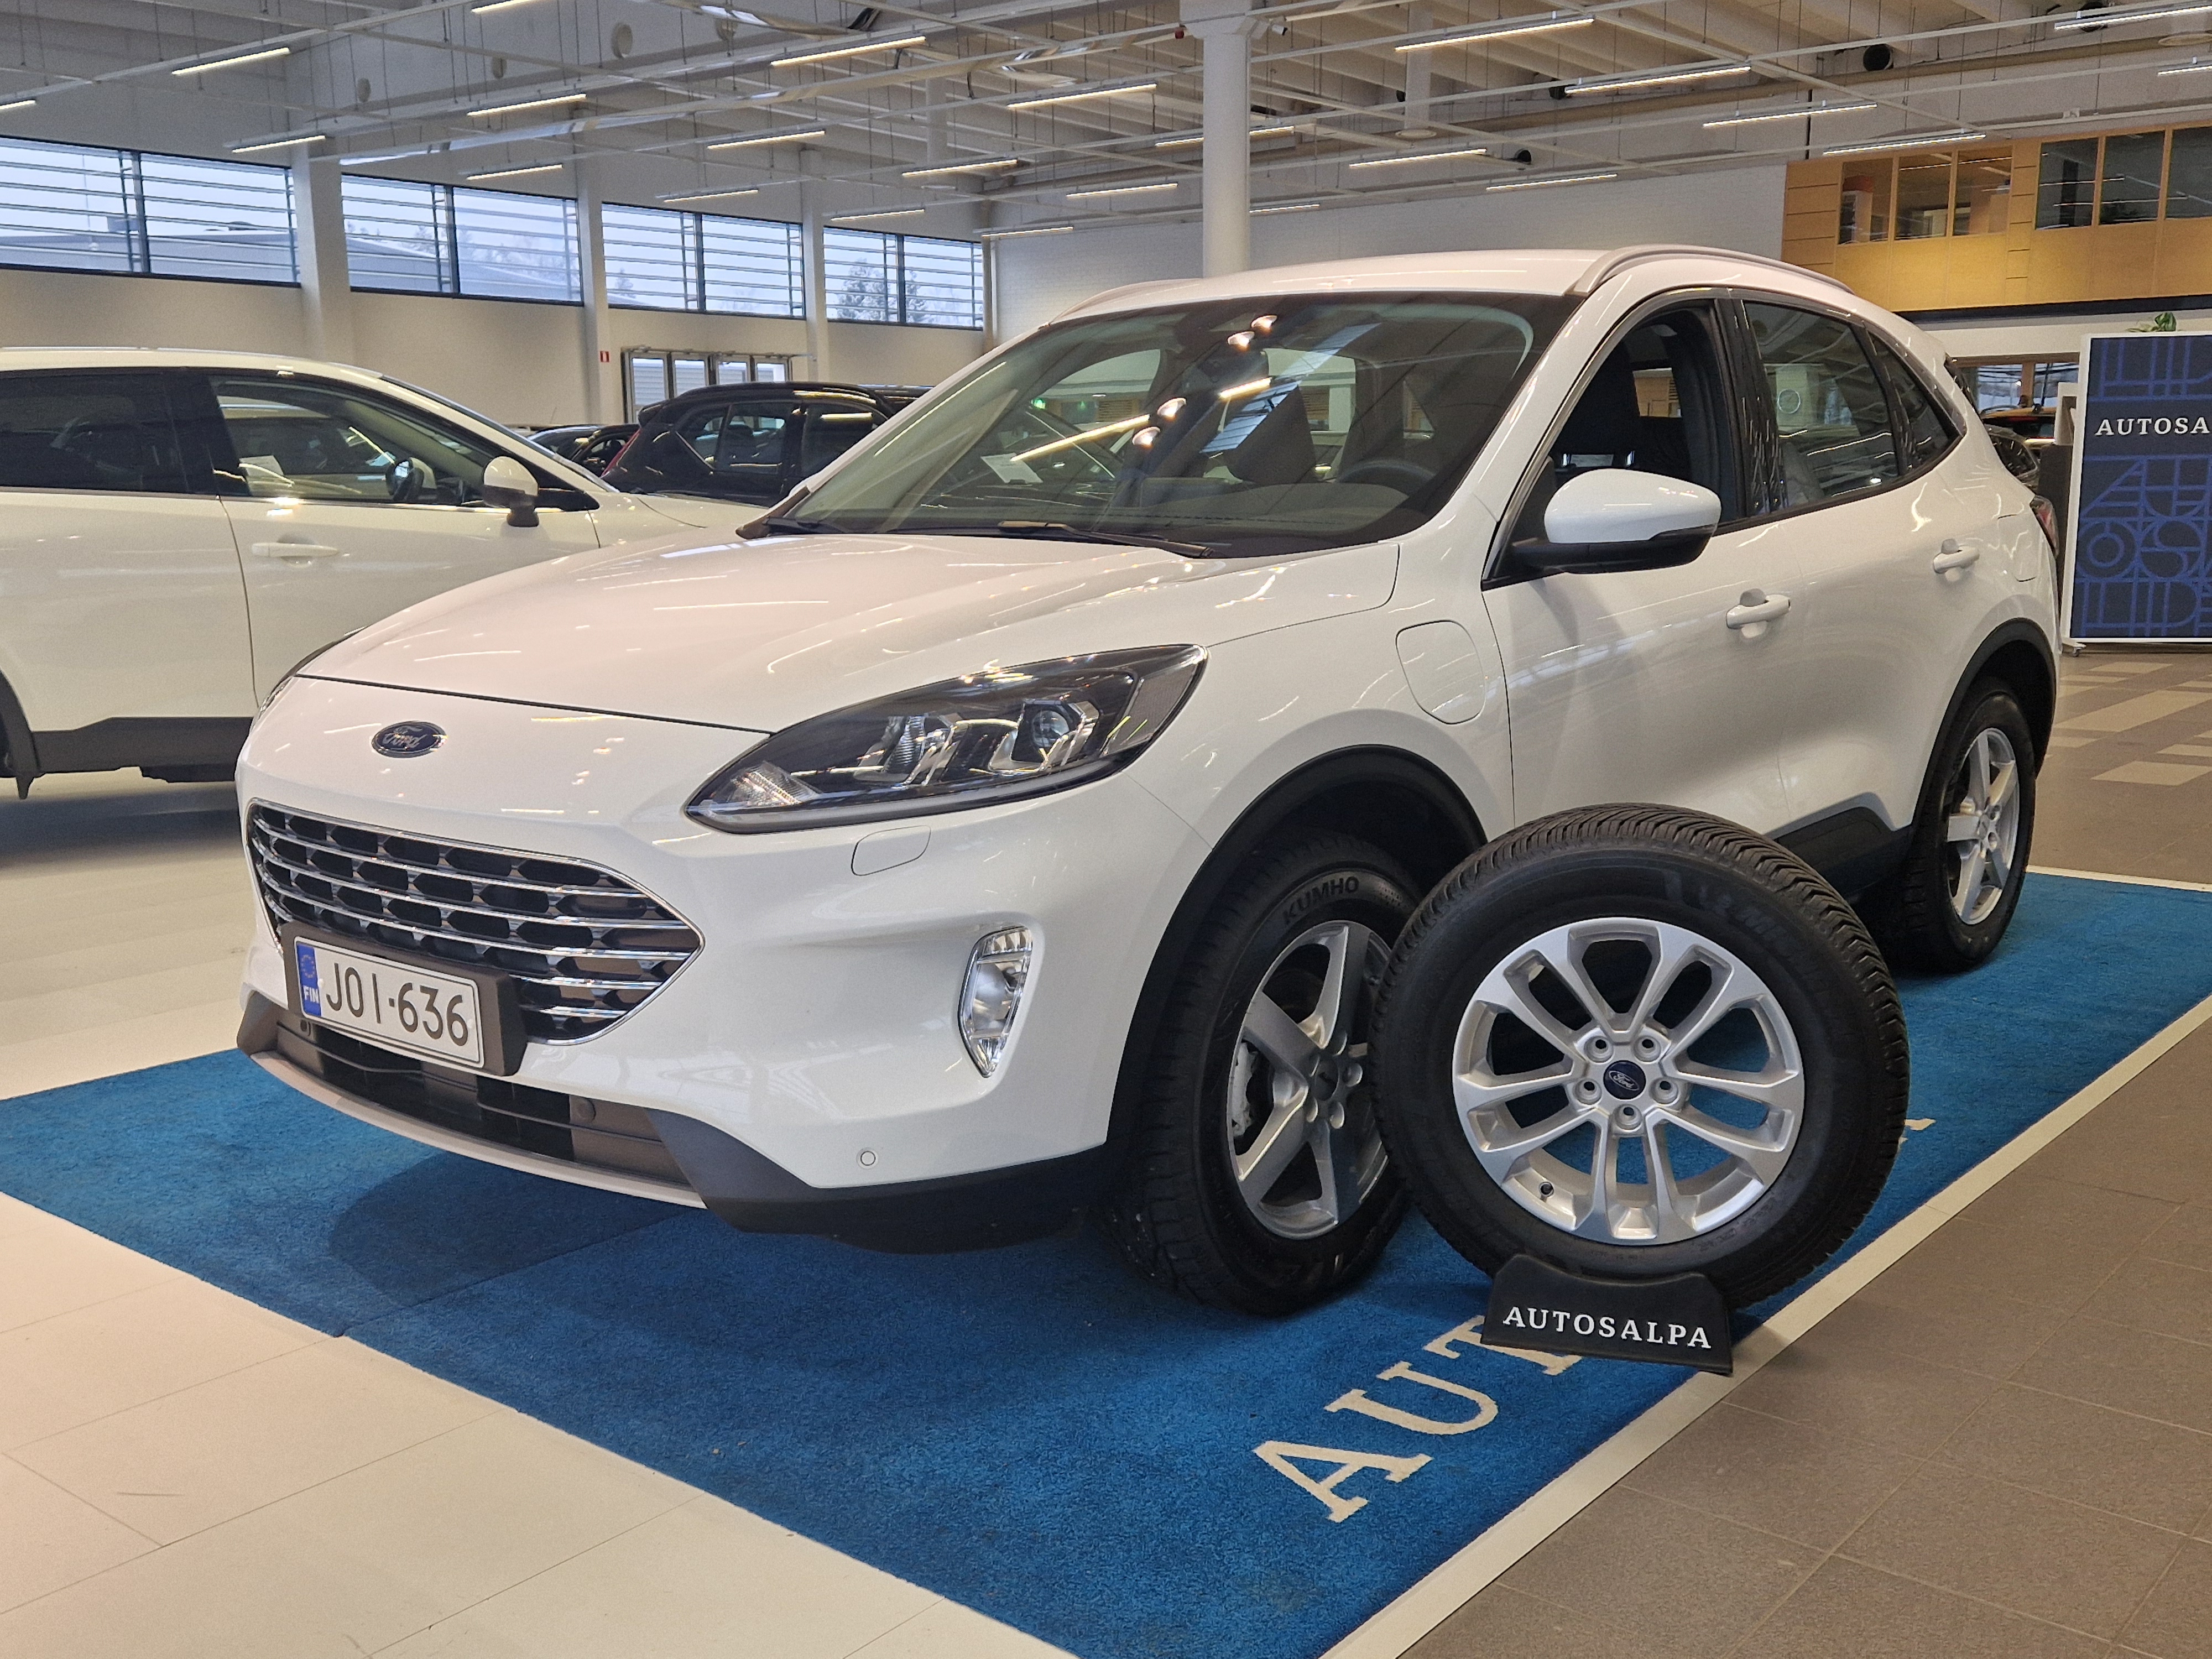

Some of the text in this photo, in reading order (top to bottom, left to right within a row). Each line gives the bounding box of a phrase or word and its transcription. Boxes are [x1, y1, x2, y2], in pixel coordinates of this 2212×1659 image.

[2094, 416, 2210, 436] AUTOSA
[382, 726, 427, 747] Ford
[1282, 876, 1360, 925] KUMHO
[303, 985, 319, 1004] FIN
[326, 963, 469, 1046] JOI-636
[1502, 1306, 1712, 1349] AUTOSALPA
